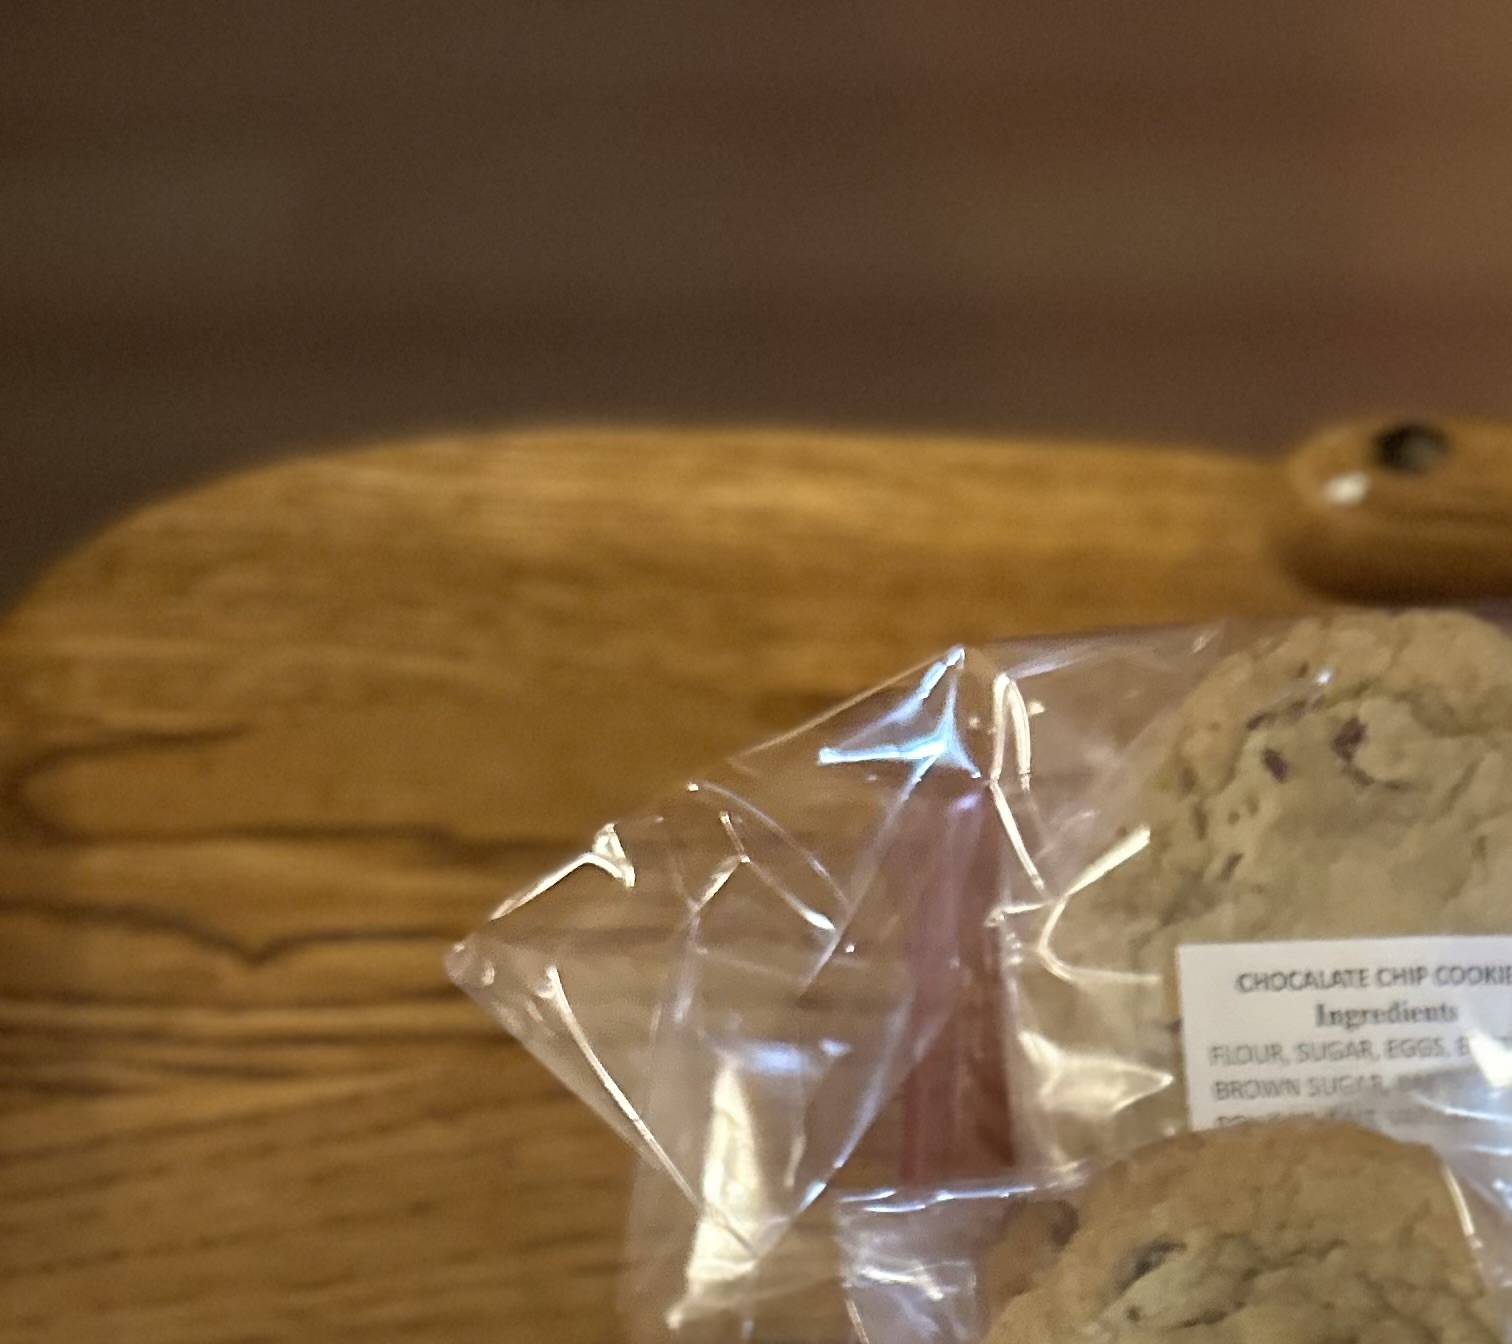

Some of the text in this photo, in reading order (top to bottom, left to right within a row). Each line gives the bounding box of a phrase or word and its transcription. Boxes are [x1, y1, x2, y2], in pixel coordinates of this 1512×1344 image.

[1236, 967, 1368, 993] CHOCALATE
[1377, 965, 1428, 987] CHIP
[1315, 1002, 1459, 1030] Ingredients
[1213, 1078, 1301, 1101] BROWN
